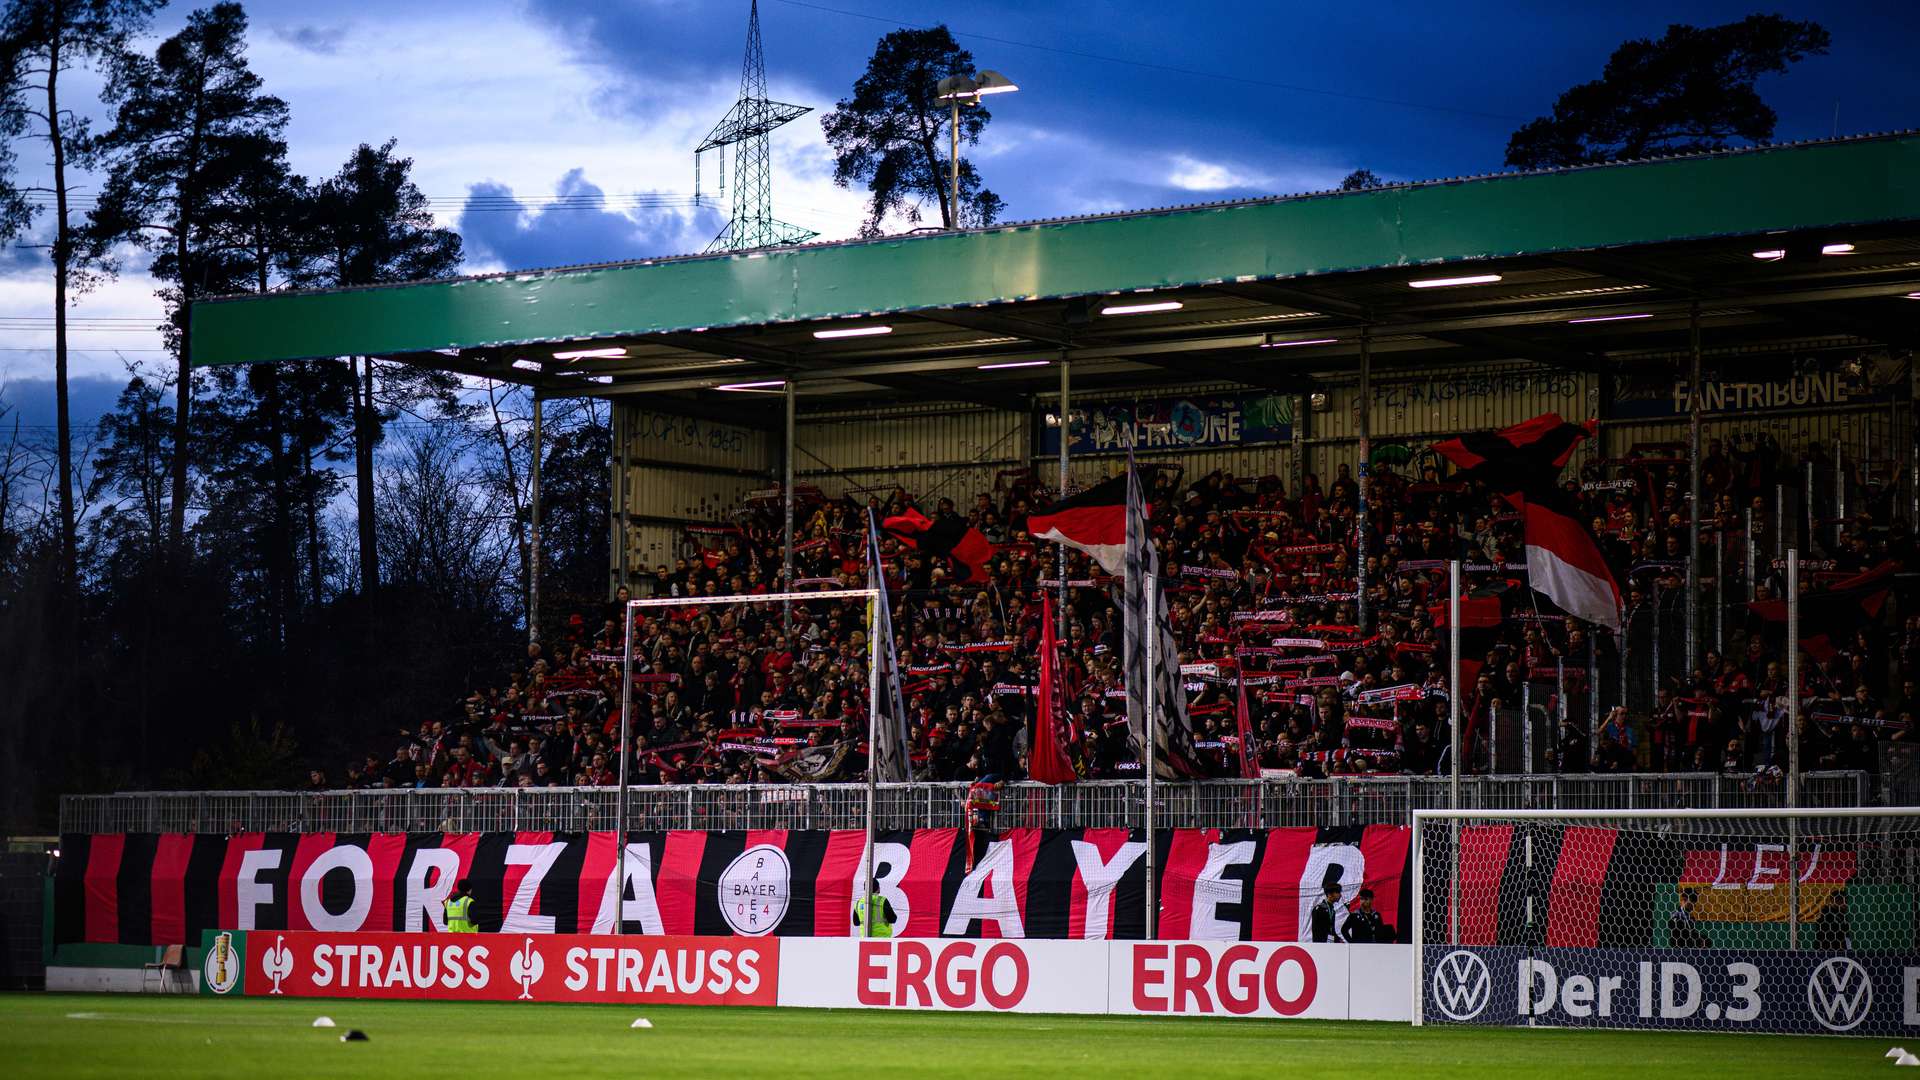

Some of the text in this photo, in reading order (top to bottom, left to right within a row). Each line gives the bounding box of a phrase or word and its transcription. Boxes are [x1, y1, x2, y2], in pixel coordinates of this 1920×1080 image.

[236, 841, 665, 935] FORZA
[734, 884, 776, 896] BAYER
[849, 838, 1365, 942] BAYER
[311, 944, 489, 990] STRAUSS
[564, 947, 760, 995] STRAUSS
[856, 940, 1030, 1010] ERGO
[1132, 943, 1318, 1016] ERGO
[1518, 959, 1761, 1022] Der ID.3
